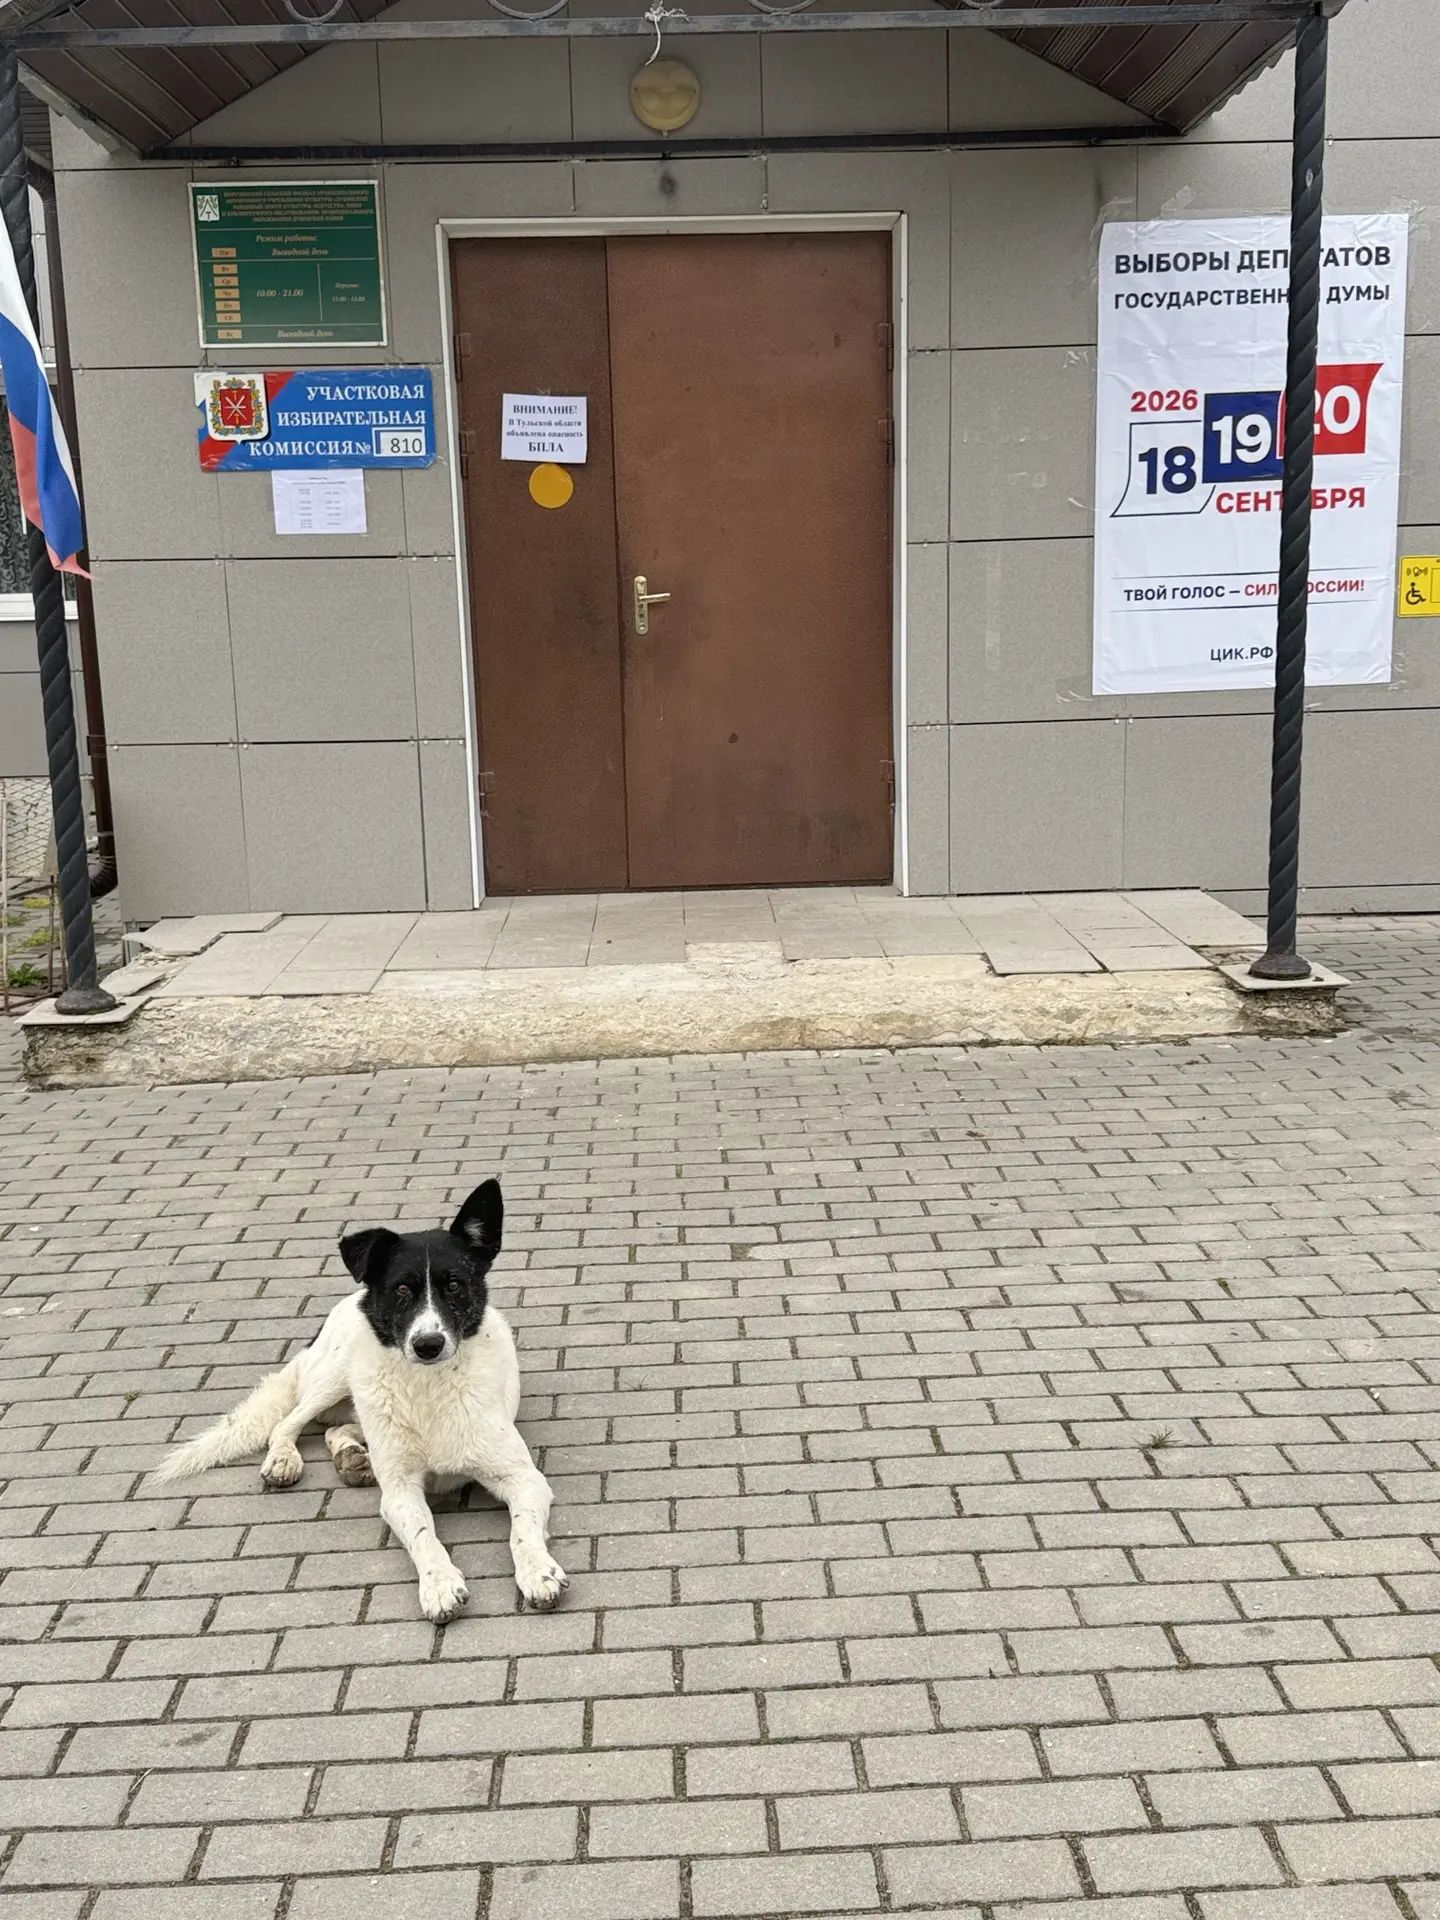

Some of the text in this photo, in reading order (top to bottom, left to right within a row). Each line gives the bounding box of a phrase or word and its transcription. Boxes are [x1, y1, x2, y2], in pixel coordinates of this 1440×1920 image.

[1114, 246, 1391, 275] ВЫБОРЫ ДЕПАТОВ
[282, 289, 304, 297] 21.00
[1114, 284, 1390, 309] ГОСУДАРСТВЕНН ДУМЫ
[307, 384, 425, 401] УЧАСТКОВАЯ
[1130, 389, 1198, 412] 2026
[277, 410, 426, 426] ИЗБИРАТЕЛЬНАЯ
[513, 405, 578, 414] ВНИМАНИЕ!
[516, 419, 552, 428] Тульской
[249, 440, 353, 456] КОМИССИЯ
[390, 438, 422, 454] 810
[528, 442, 564, 453] БПЛА
[1138, 384, 1361, 495] 18 19 0
[1215, 487, 1366, 513] СЕНТБРЯ
[1124, 585, 1166, 601] ТВОЙ
[1172, 585, 1226, 600] ГОЛОС
[1244, 582, 1280, 597] СИЛ
[1307, 580, 1365, 594] ОССИИ!
[1210, 646, 1274, 662] ЦИК.РФ
